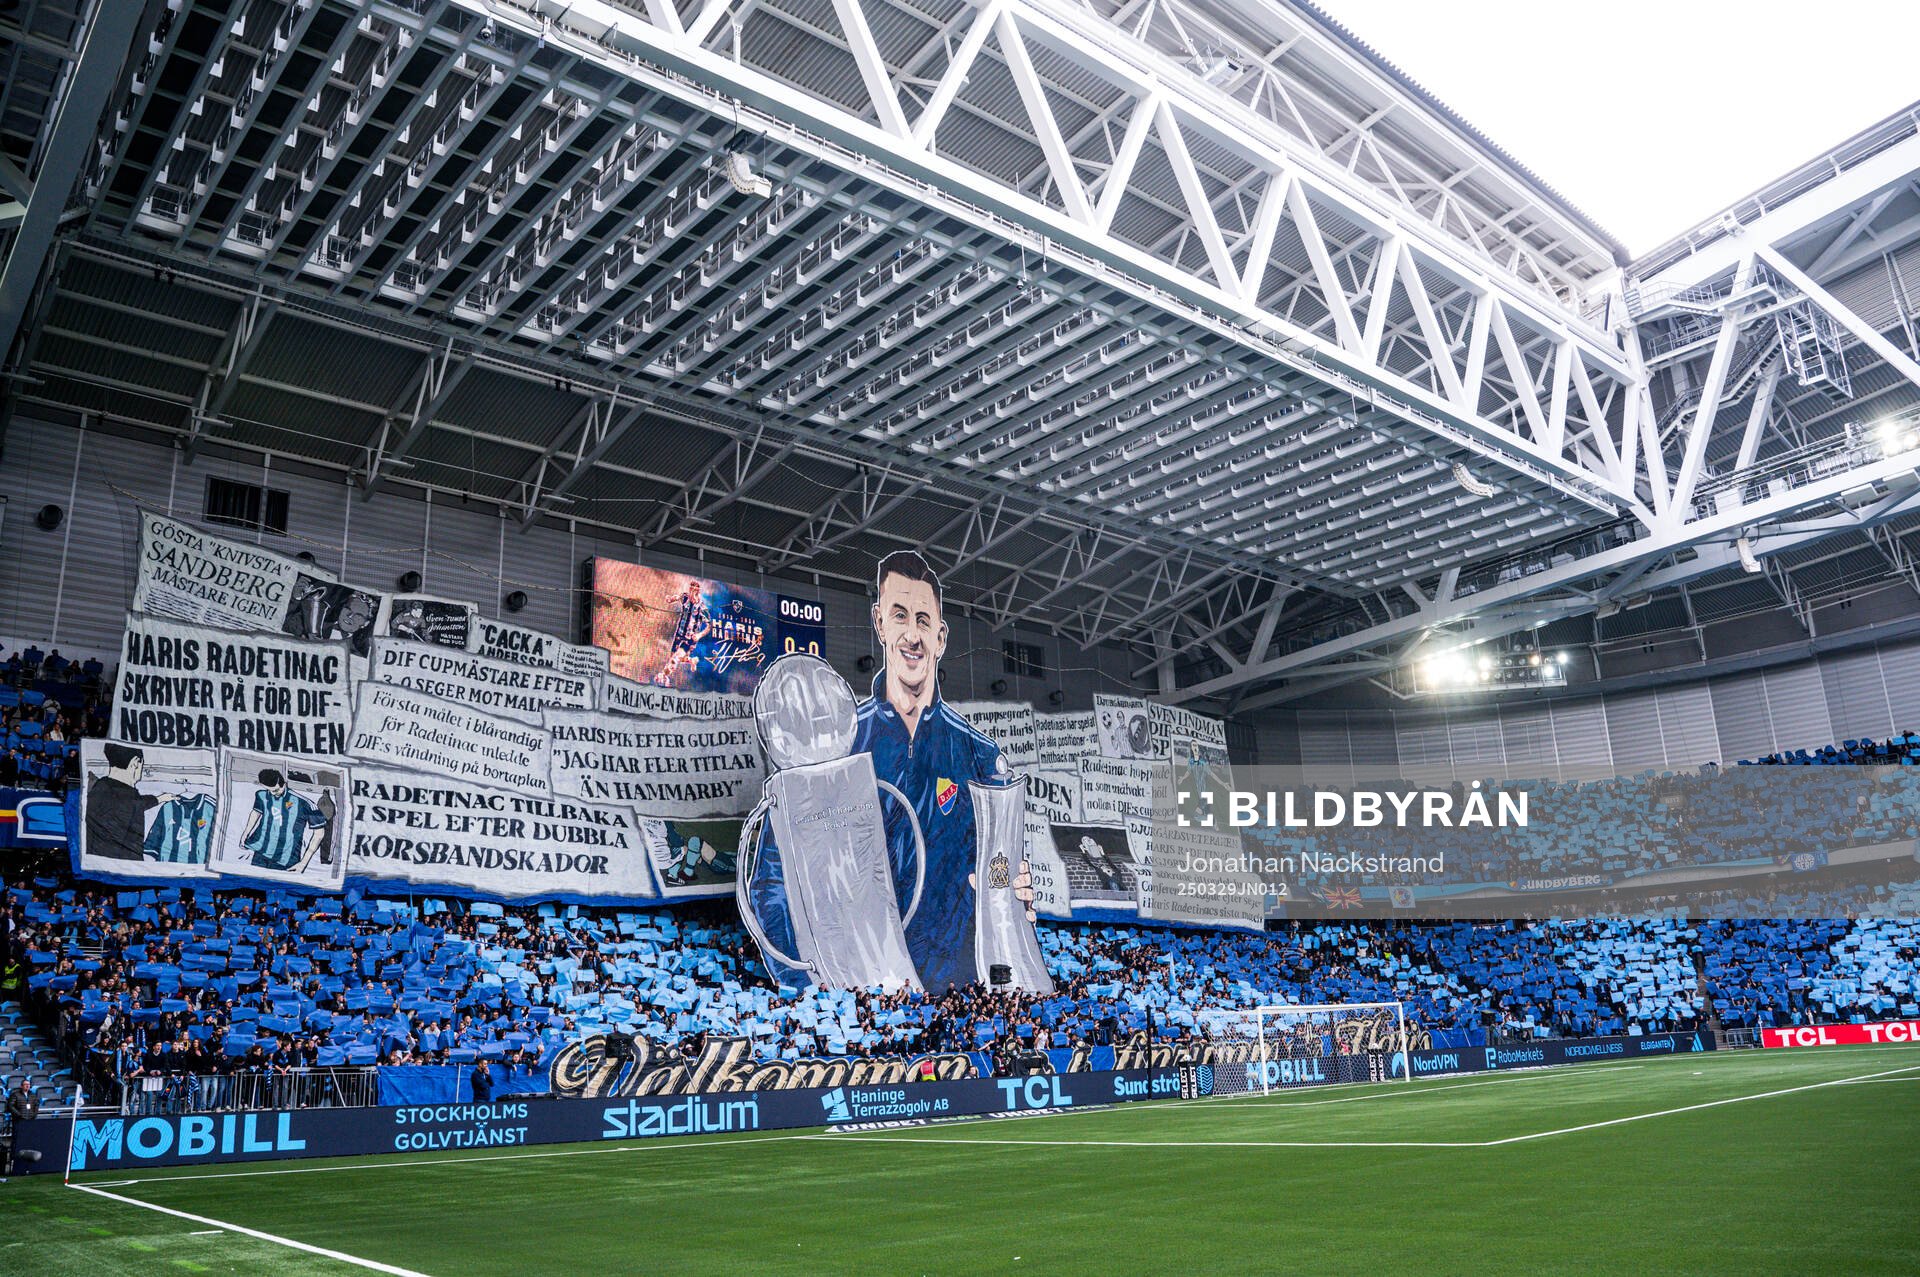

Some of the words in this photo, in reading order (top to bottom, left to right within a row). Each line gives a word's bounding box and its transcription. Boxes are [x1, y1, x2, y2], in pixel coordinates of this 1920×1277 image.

[151, 520, 203, 551] GÖSTA
[147, 540, 286, 603] SANDBERG
[152, 567, 229, 606] MÄSTARE
[231, 595, 277, 620] IGEN!
[780, 600, 822, 622] 00:00
[712, 618, 763, 635] HARIS
[128, 631, 200, 672] HARIS
[206, 640, 339, 685] RADETINAC
[383, 650, 416, 667] DIF
[418, 653, 531, 689] CUPMÄSTARE
[533, 674, 585, 696] EFTER
[122, 672, 214, 709] SKRIVER
[221, 677, 246, 712] PÅ
[254, 685, 292, 715] FÖR
[298, 689, 341, 718] DIF-
[416, 678, 465, 700] SEGER
[469, 688, 503, 706] MOT
[373, 690, 420, 715] Första
[424, 706, 462, 728] målet
[466, 717, 471, 730] i
[473, 719, 544, 751] blårandigt
[677, 697, 712, 716] RIKTIG
[120, 707, 230, 749] NOBBAR
[238, 718, 345, 755] RIVALEN
[1150, 704, 1176, 724] SVEN
[1178, 711, 1224, 738] LINDMAN
[378, 715, 405, 733] för
[407, 721, 478, 753] Radetinac
[481, 744, 530, 767] inledde
[552, 725, 606, 745] HARIS
[608, 732, 633, 747] PIK
[636, 733, 685, 749] EFTER
[688, 730, 752, 748] GULDET:
[1010, 740, 1035, 755] Molde
[354, 733, 391, 753] DIF:s
[395, 743, 459, 771] vändning
[461, 760, 479, 775] på
[483, 763, 547, 789] bortaplan
[602, 754, 640, 773] HAR
[644, 756, 689, 774] FLER
[690, 753, 756, 772] TITLAR
[1082, 758, 1127, 776] Radetinac
[1129, 763, 1170, 781] hoppade
[580, 774, 610, 798] ÄN
[1084, 779, 1093, 791] in
[353, 779, 505, 811] RADETINAC
[510, 797, 629, 828] TILLBAKA
[355, 804, 366, 822] I
[372, 805, 440, 830] SPEL
[445, 814, 525, 838] EFTER
[532, 821, 629, 849] DUBBLA
[352, 833, 609, 875] KORSBANDSKADOR
[1146, 841, 1175, 854] HARIS
[1171, 900, 1219, 916] Radetinacs
[1220, 907, 1240, 918] sista
[1641, 1040, 1671, 1050] ELGIGANTEN
[1775, 1027, 1836, 1047] TCL
[1862, 1022, 1920, 1042] TCL
[1413, 1053, 1458, 1072] NordVPN
[1498, 1048, 1544, 1064] RoboMarkets
[1114, 1074, 1181, 1096] Sundströ
[1181, 1066, 1189, 1099] SELECT
[1190, 1066, 1199, 1099] SELECT
[1247, 1058, 1325, 1090] MOBILL
[851, 1088, 905, 1105] Haninge
[997, 1076, 1072, 1110] TCL
[395, 1103, 528, 1124] STOCKHOLMS
[602, 1096, 759, 1138] stadium
[852, 1099, 931, 1118] Terrazzogolv
[934, 1099, 949, 1110] AB
[988, 1106, 1065, 1119] UNIBET
[394, 1121, 528, 1150] GOLVTJÄNST
[842, 1117, 927, 1132] UNIBET
[71, 1112, 306, 1171] MOBILL
